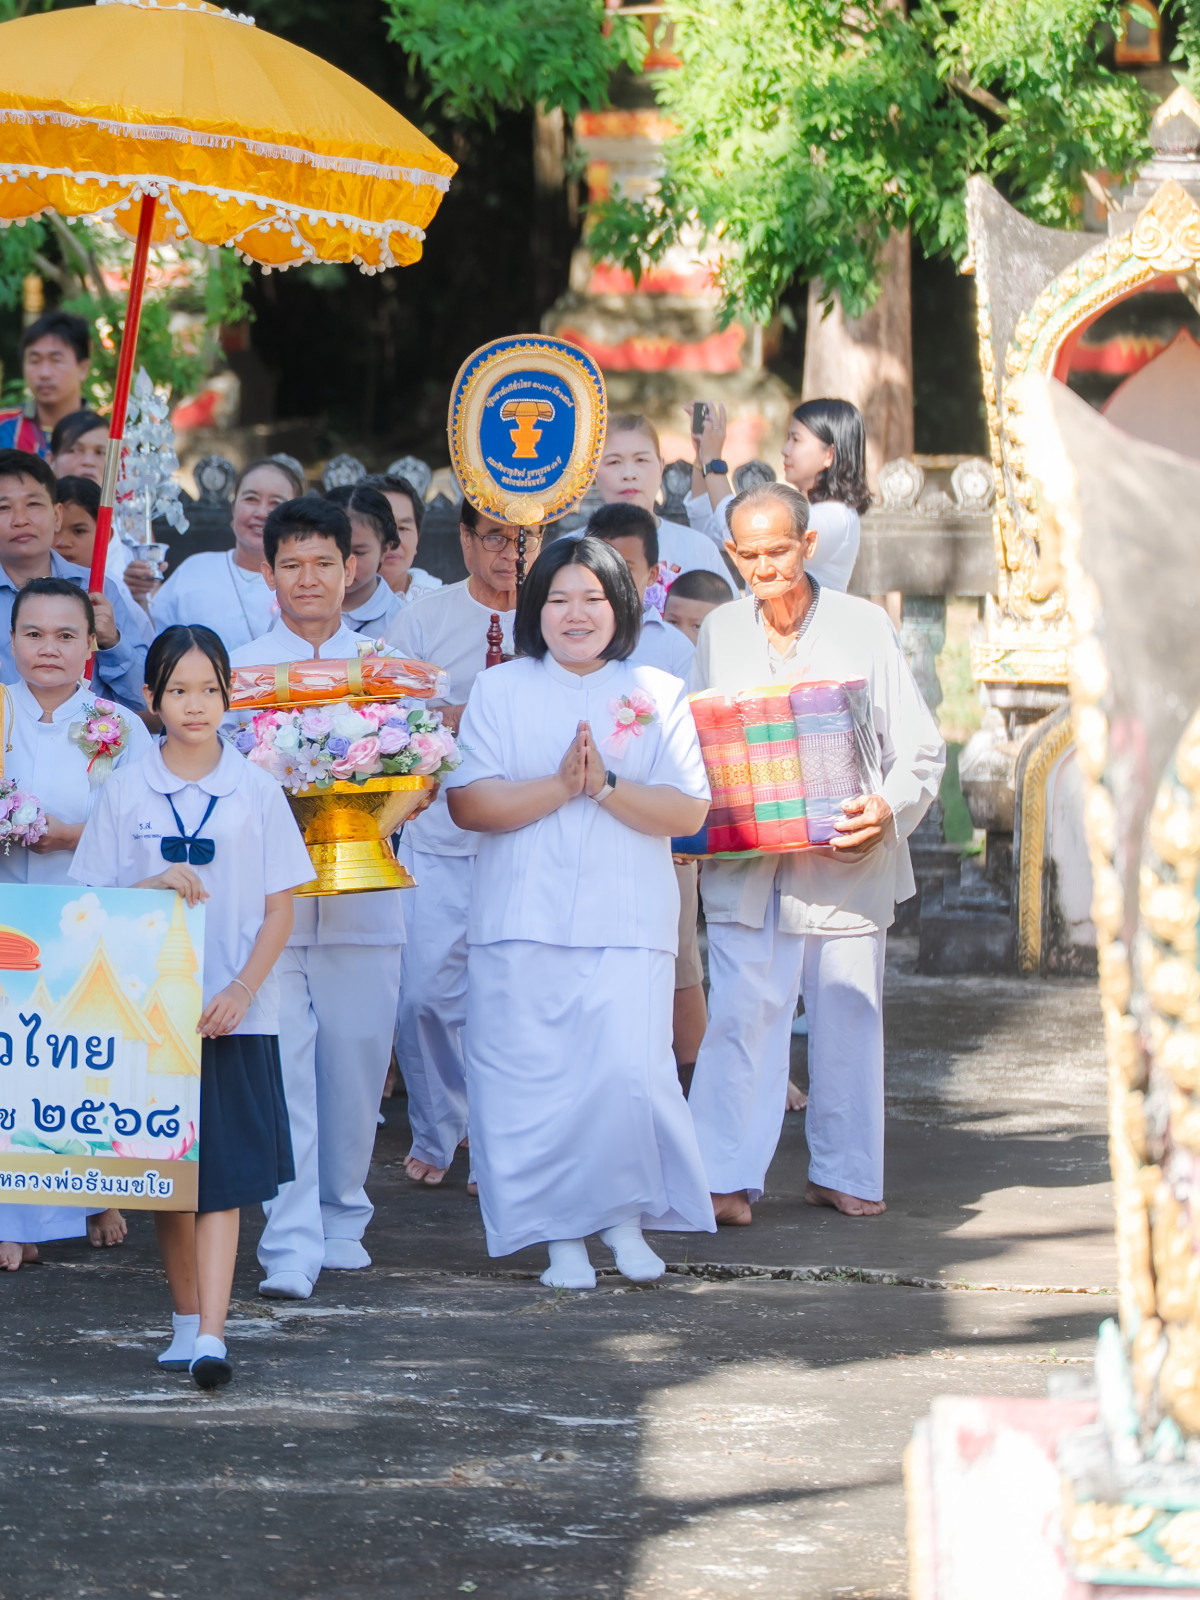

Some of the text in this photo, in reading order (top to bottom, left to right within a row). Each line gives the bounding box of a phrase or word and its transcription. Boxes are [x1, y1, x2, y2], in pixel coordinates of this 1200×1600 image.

[32, 1098, 180, 1138] ๒๕๖๘
[0, 1170, 171, 1194] หลวงพ่อธัมมชโย
